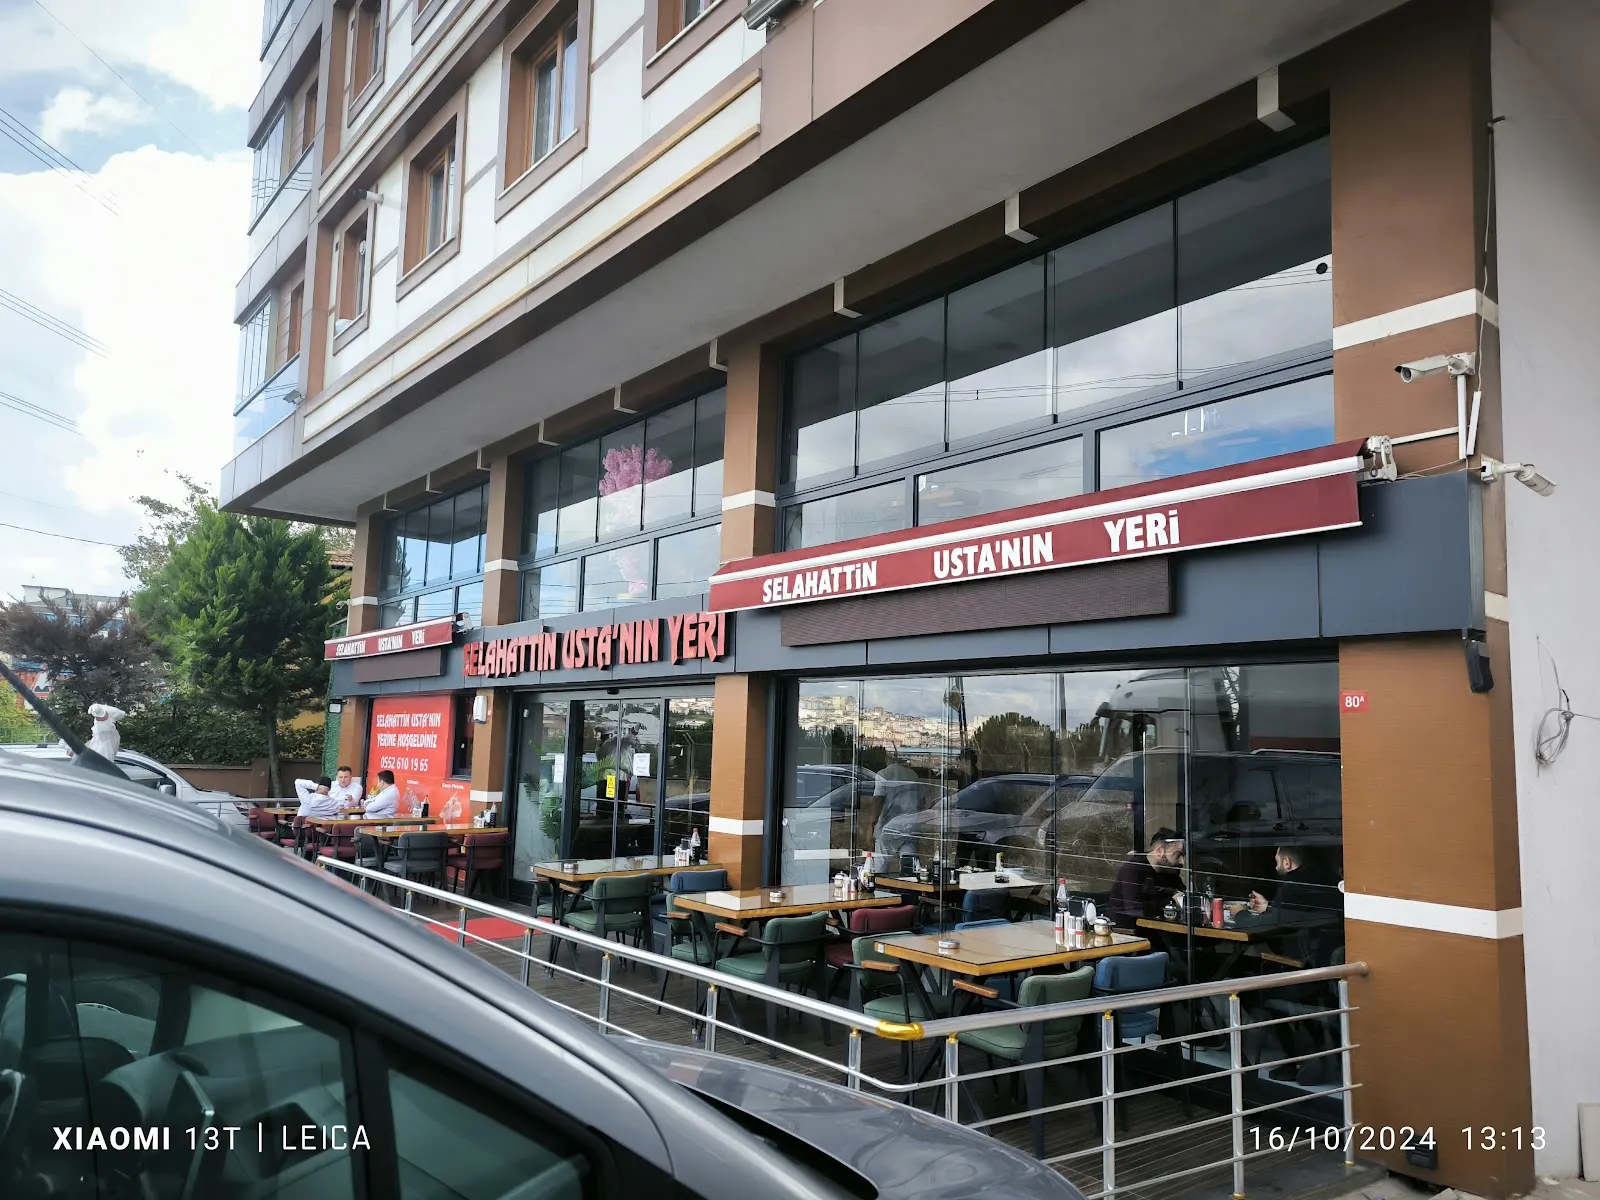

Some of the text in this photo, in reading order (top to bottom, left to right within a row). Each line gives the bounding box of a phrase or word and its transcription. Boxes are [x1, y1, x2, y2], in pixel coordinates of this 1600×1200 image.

[933, 531, 1054, 580] USTA'NIN
[561, 618, 660, 670] USTA'NIN
[380, 756, 429, 772] 0552 610 19 65
